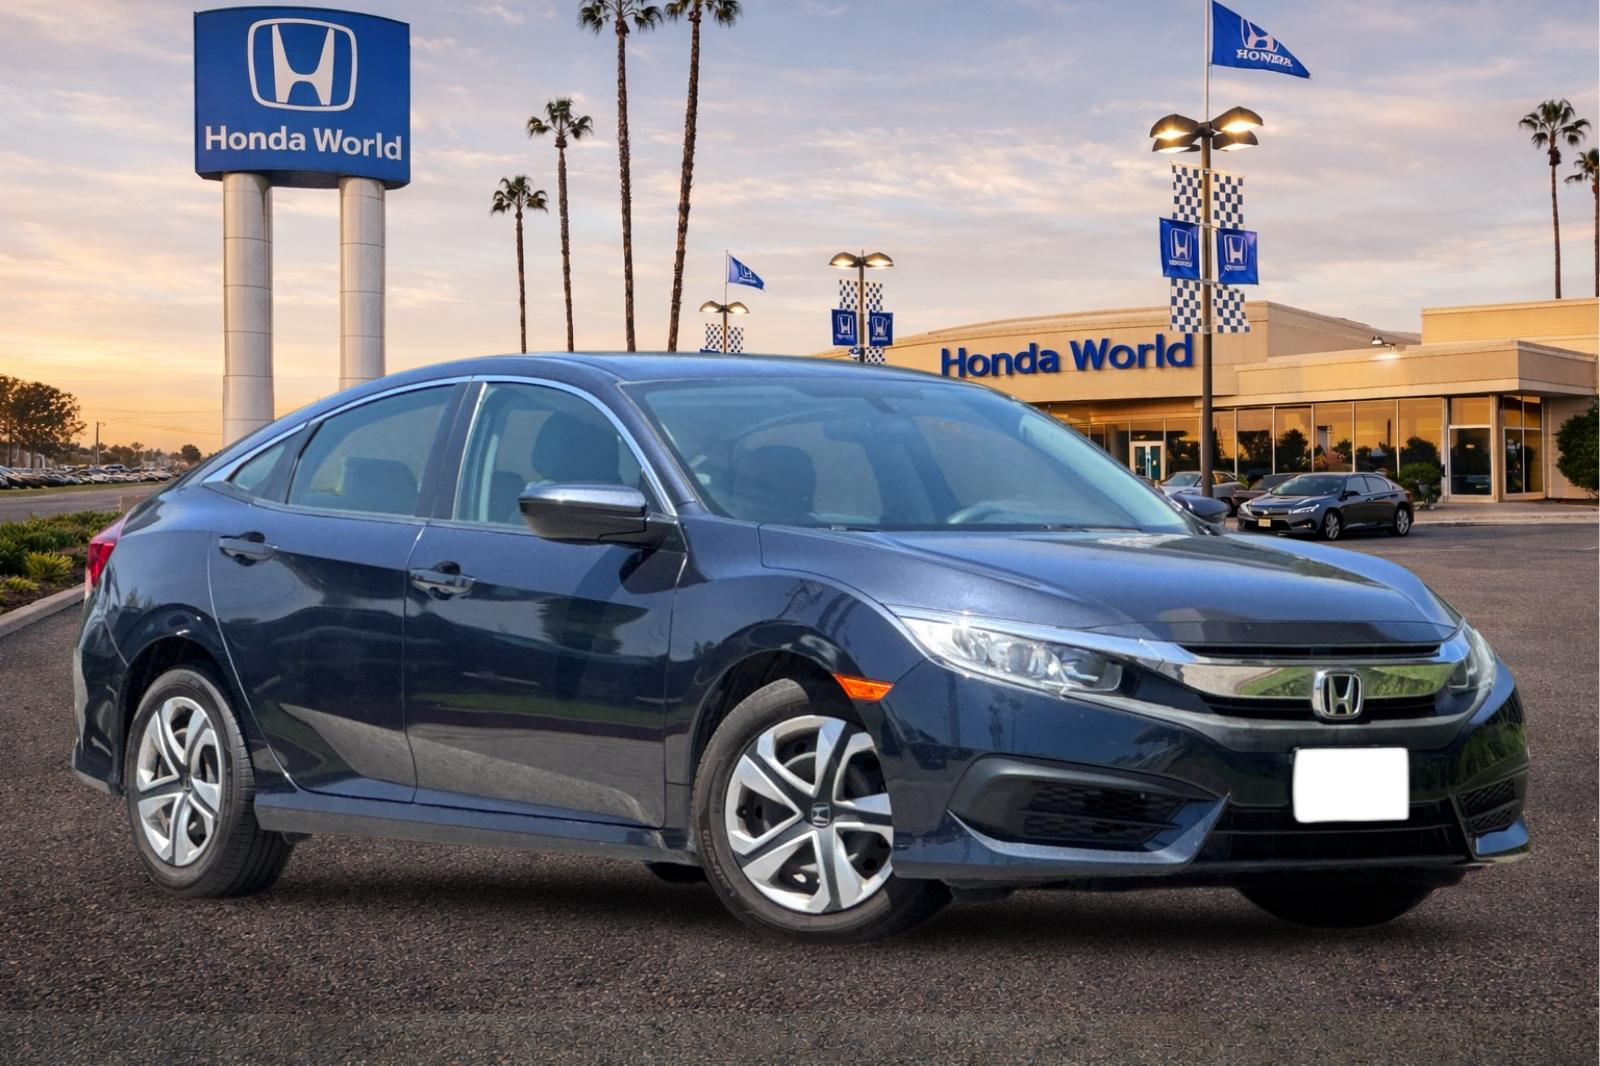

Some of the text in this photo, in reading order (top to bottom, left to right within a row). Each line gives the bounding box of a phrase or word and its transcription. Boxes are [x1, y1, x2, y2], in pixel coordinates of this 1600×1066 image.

[205, 125, 402, 161] Honda World
[941, 333, 1195, 378] Honda World
